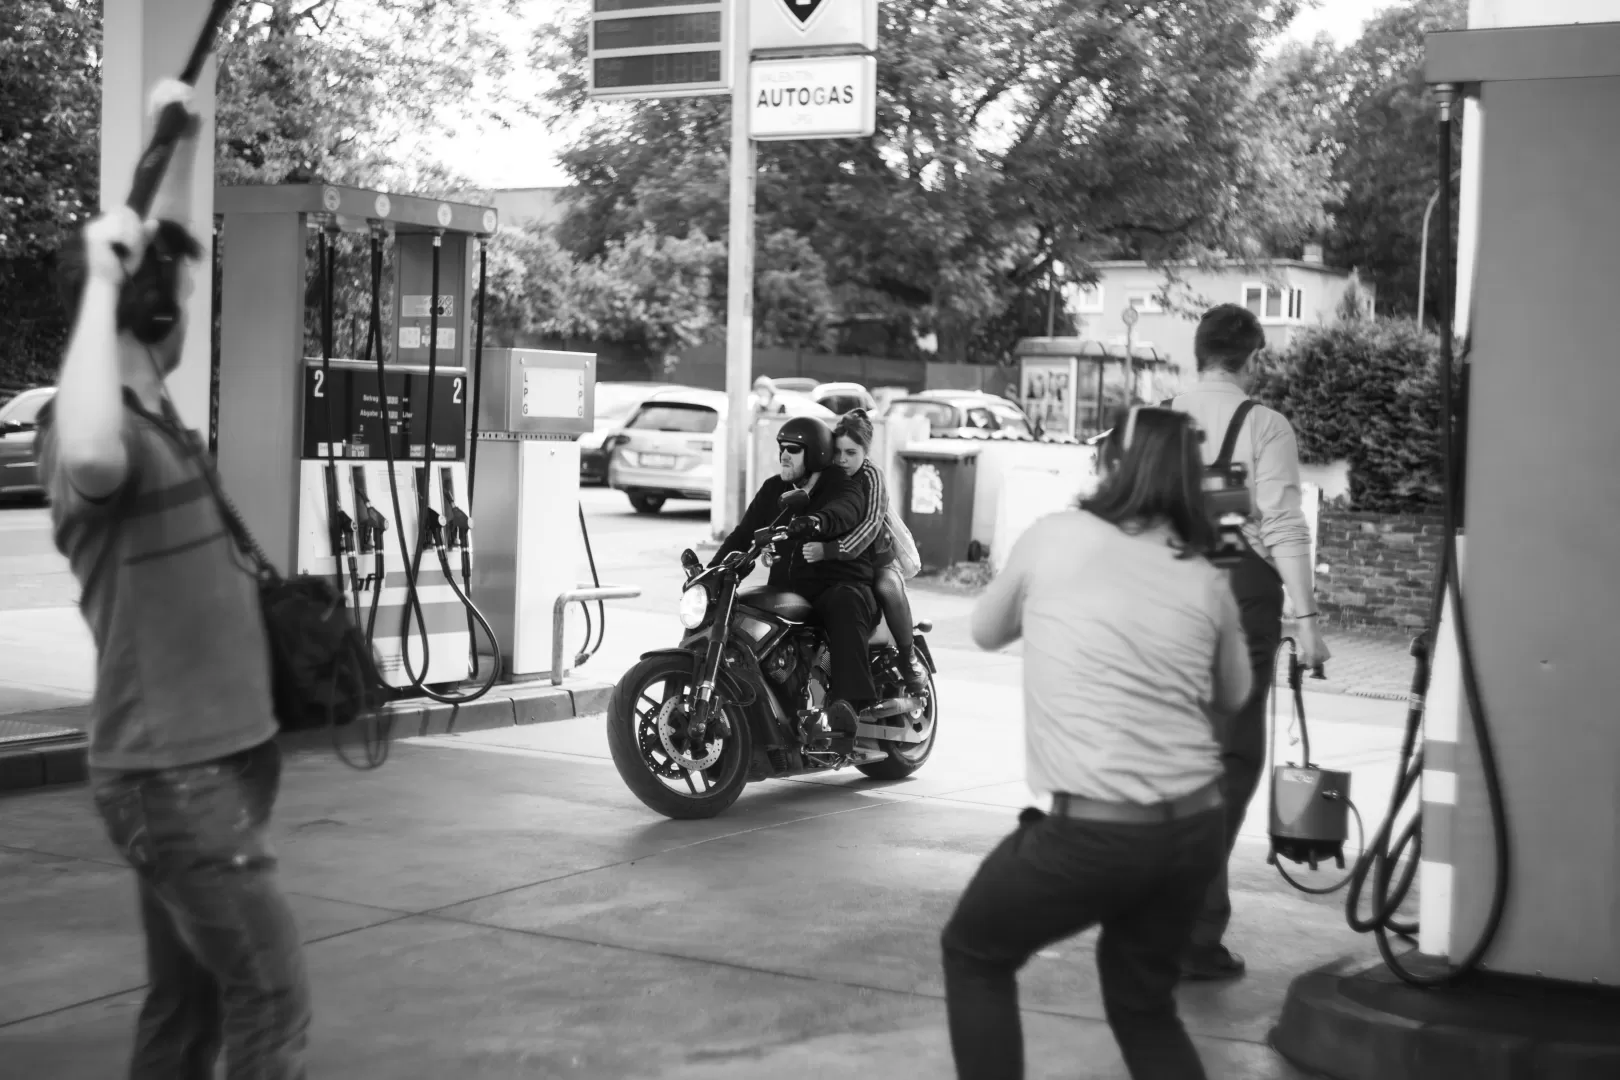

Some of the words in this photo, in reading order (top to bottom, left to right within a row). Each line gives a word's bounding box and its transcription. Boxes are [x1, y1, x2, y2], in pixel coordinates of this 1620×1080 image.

[757, 85, 853, 107] AUTOGAS
[314, 369, 324, 397] 2
[453, 377, 462, 404] 2
[360, 409, 379, 418] Abgabe
